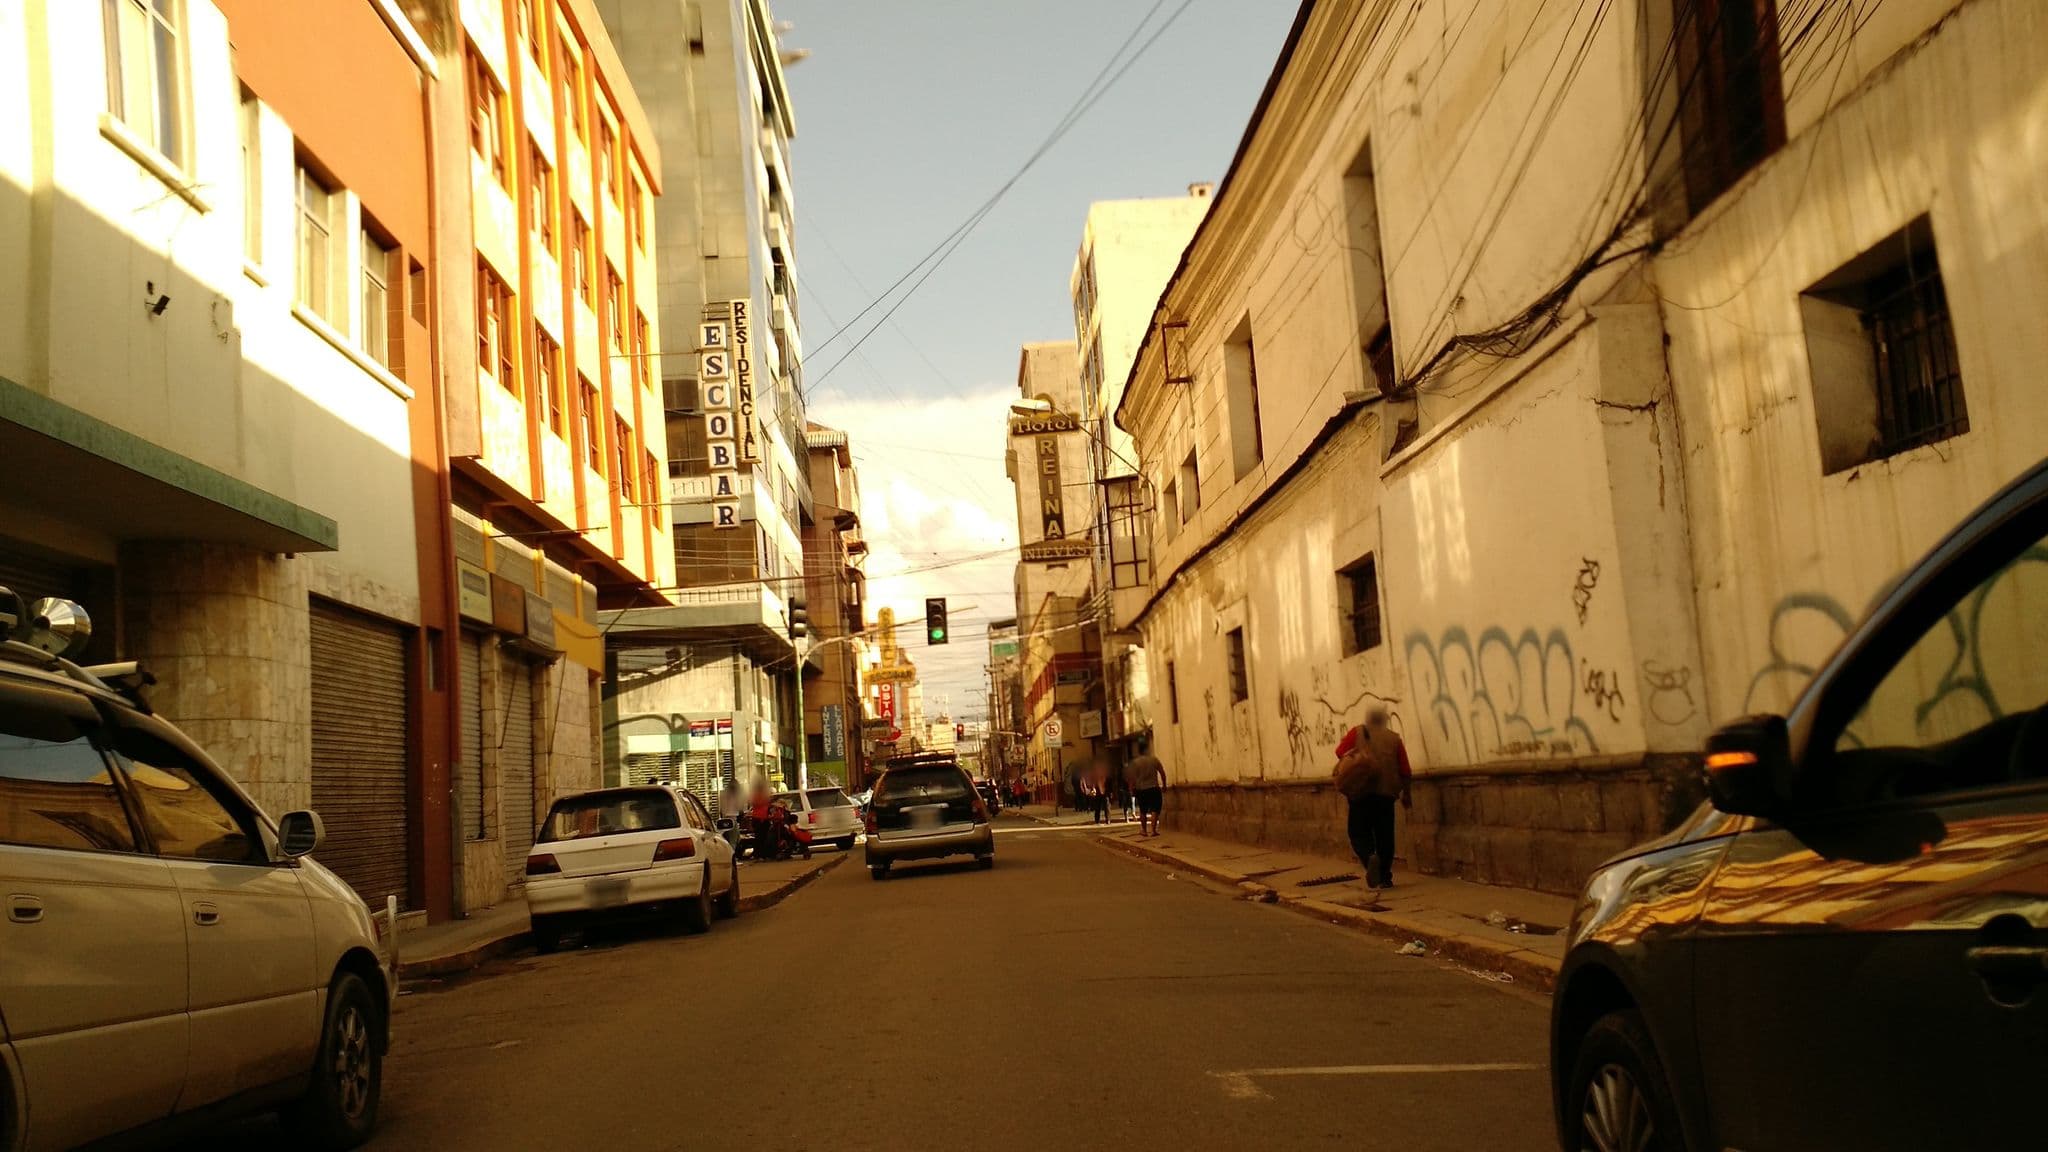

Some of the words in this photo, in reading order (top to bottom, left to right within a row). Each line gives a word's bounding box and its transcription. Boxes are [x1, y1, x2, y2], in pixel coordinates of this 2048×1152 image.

[704, 325, 734, 526] ESCOBAR
[734, 302, 756, 459] RESIDENCIAL
[1040, 440, 1063, 537] REINA
